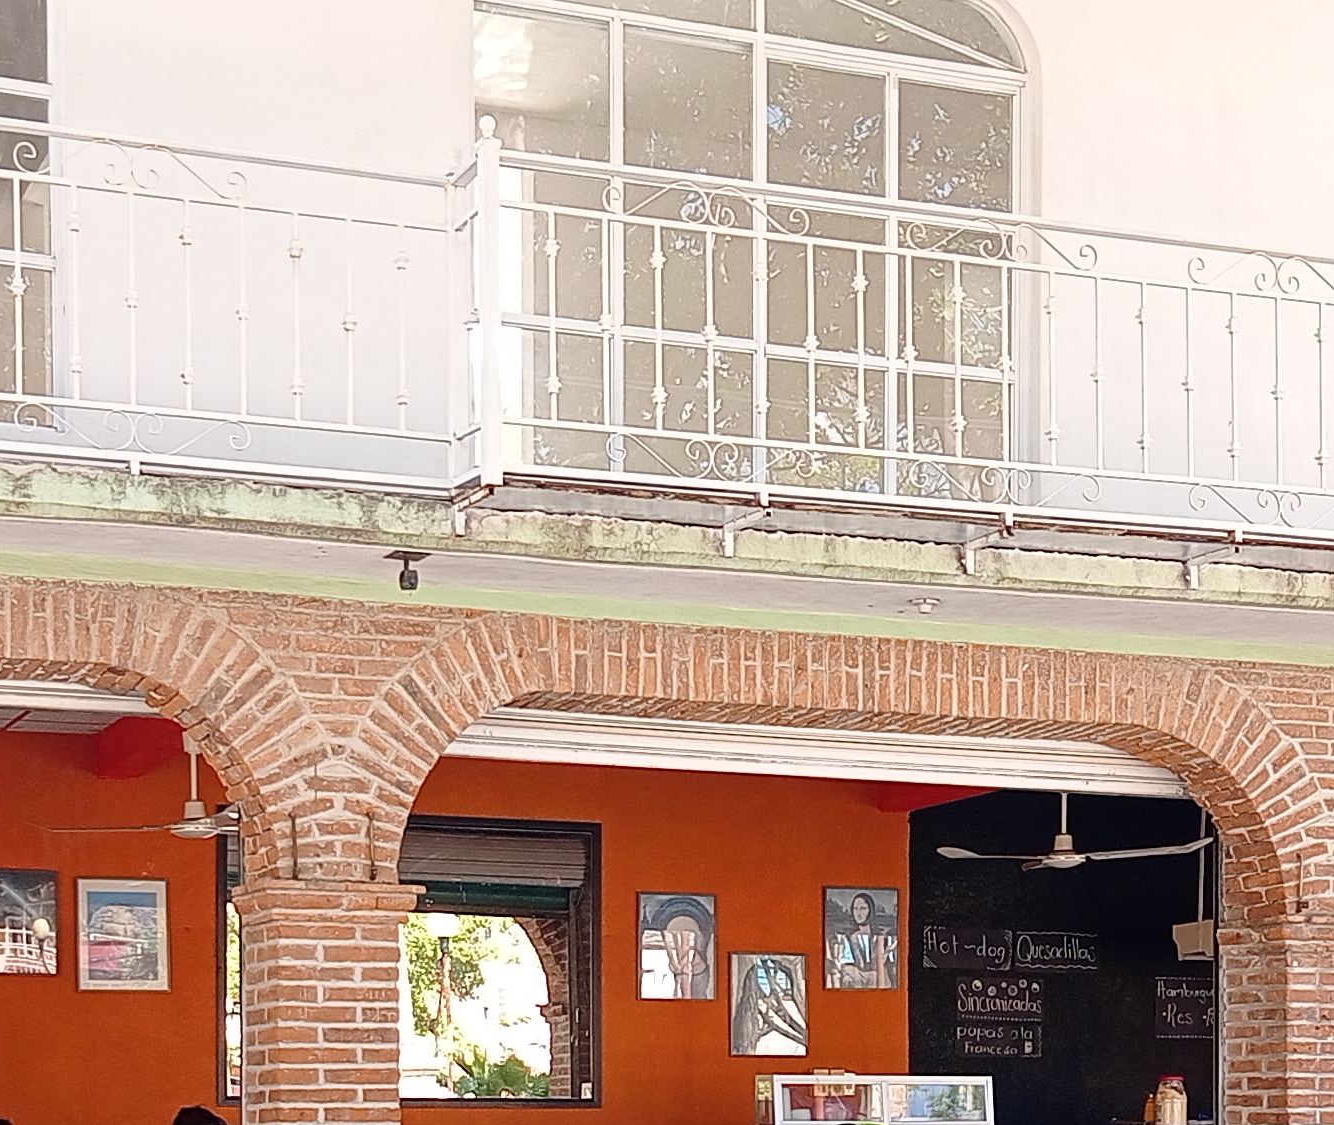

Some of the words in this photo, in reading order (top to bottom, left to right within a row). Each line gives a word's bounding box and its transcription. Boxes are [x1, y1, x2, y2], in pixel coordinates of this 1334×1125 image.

[1016, 934, 1096, 963] Quesadillas
[958, 983, 1042, 1014] Sincronizadas
[1157, 980, 1214, 1004] Hamburgu
